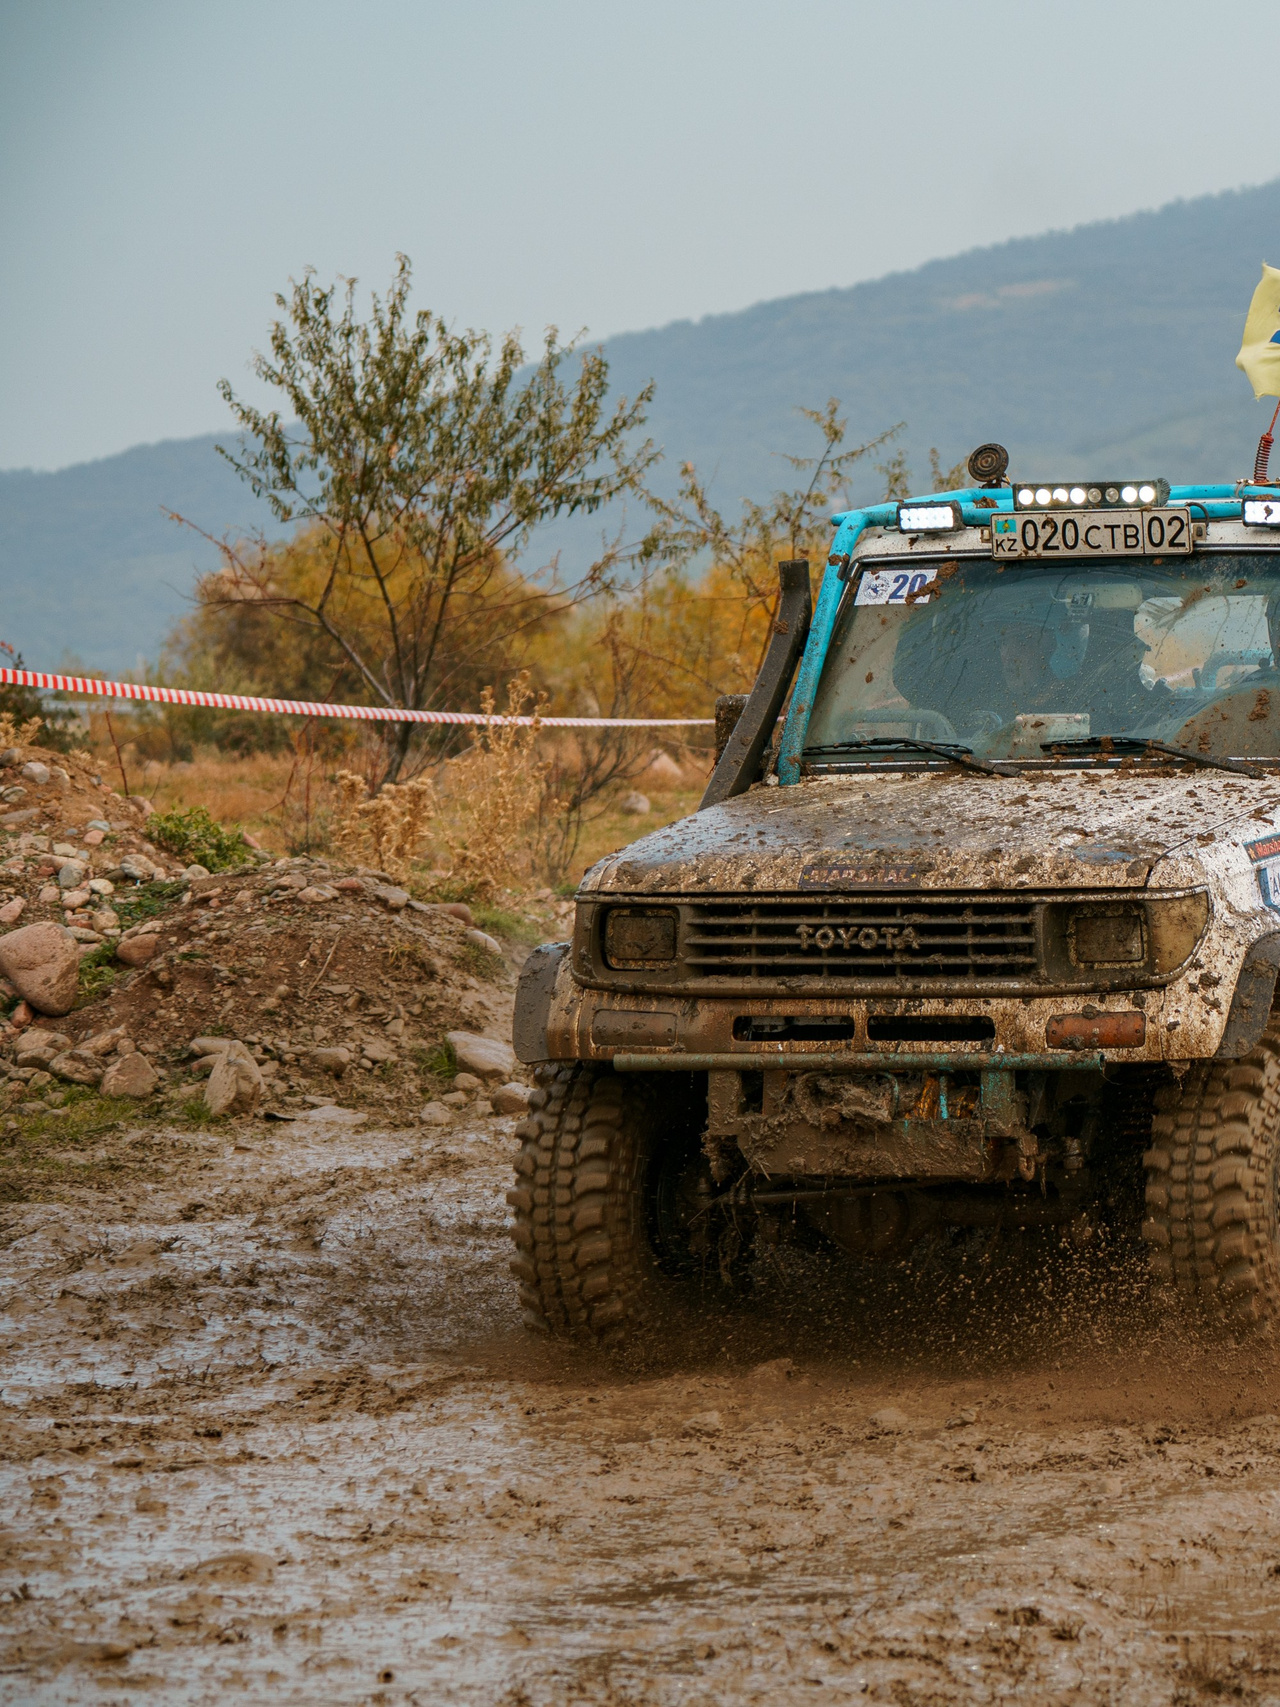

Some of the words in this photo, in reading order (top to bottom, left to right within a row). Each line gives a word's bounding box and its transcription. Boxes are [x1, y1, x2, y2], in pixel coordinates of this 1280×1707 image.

[995, 537, 1018, 553] KZ
[1147, 515, 1187, 549] 02
[888, 573, 928, 600] 20
[796, 924, 920, 950] TOYOTA
